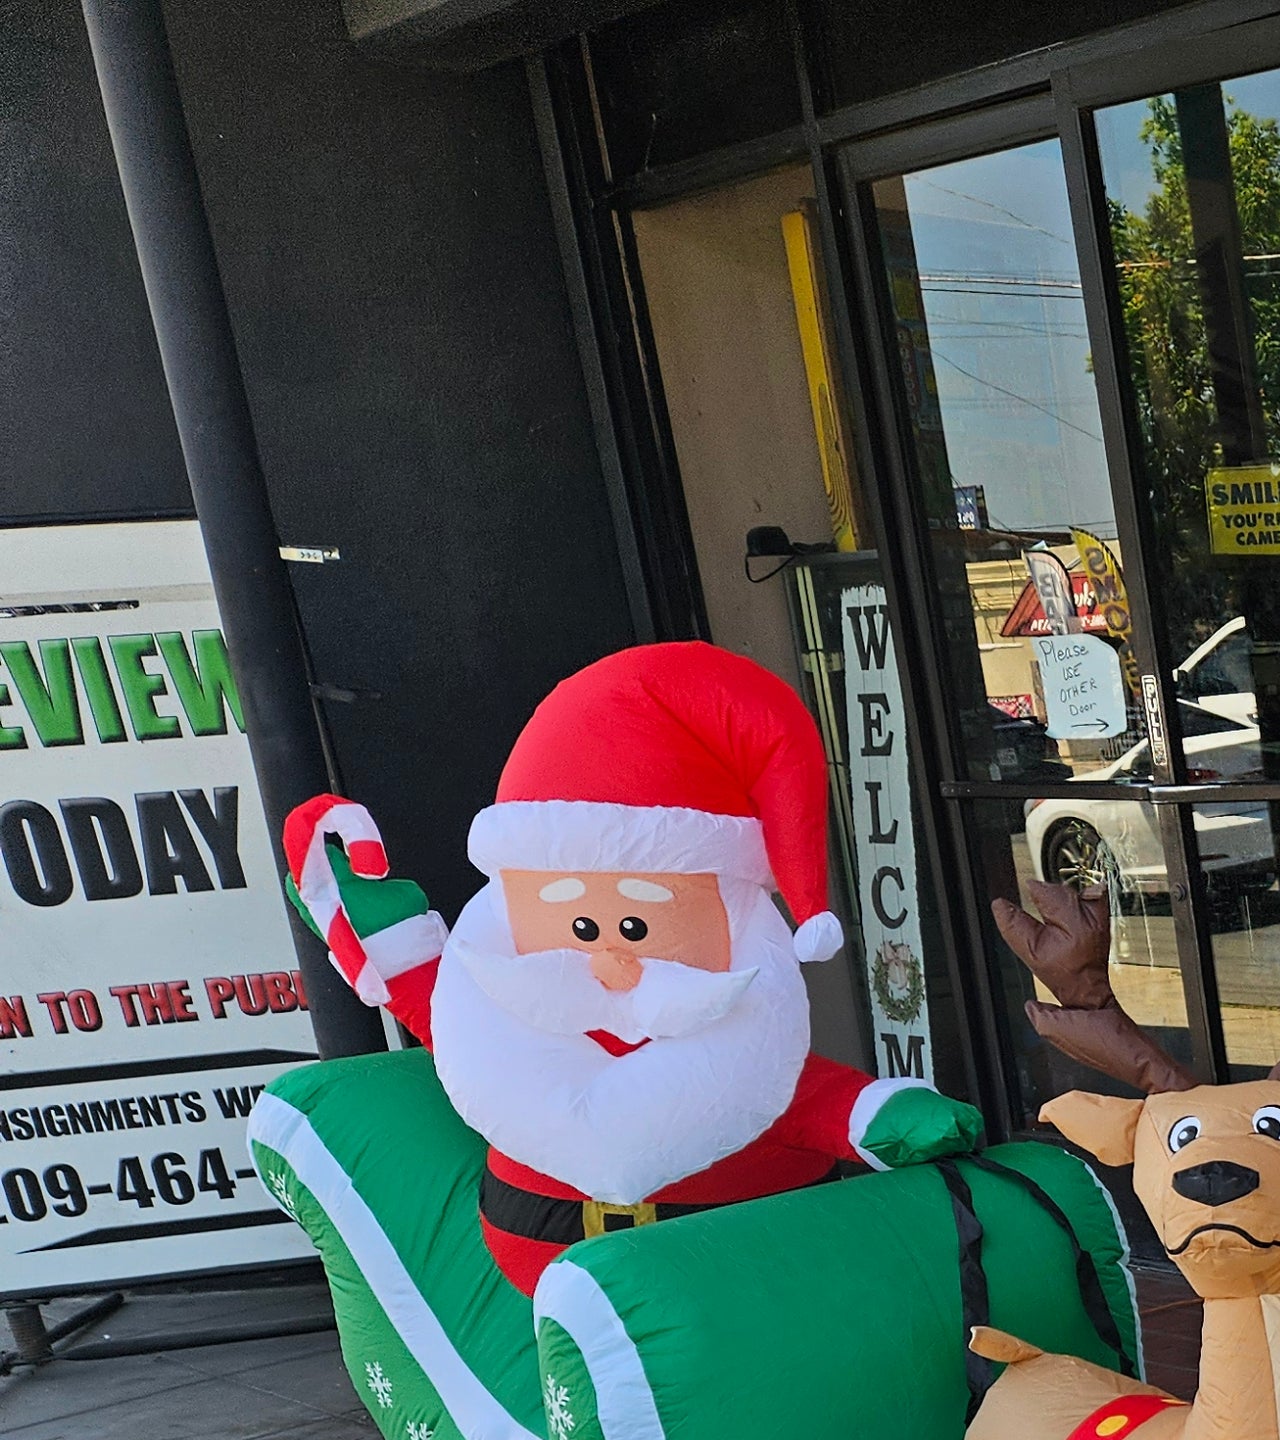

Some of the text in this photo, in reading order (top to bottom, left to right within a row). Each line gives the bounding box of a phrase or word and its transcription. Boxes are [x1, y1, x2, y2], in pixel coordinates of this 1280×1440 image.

[1039, 640, 1089, 666] Please
[1063, 662, 1083, 681] USE
[1060, 677, 1098, 704] OTHER
[1069, 702, 1097, 716] Door
[1145, 683, 1163, 742] PULL
[37, 988, 104, 1034] TO
[109, 980, 200, 1028] THE
[0, 1147, 258, 1224] 09-464-
